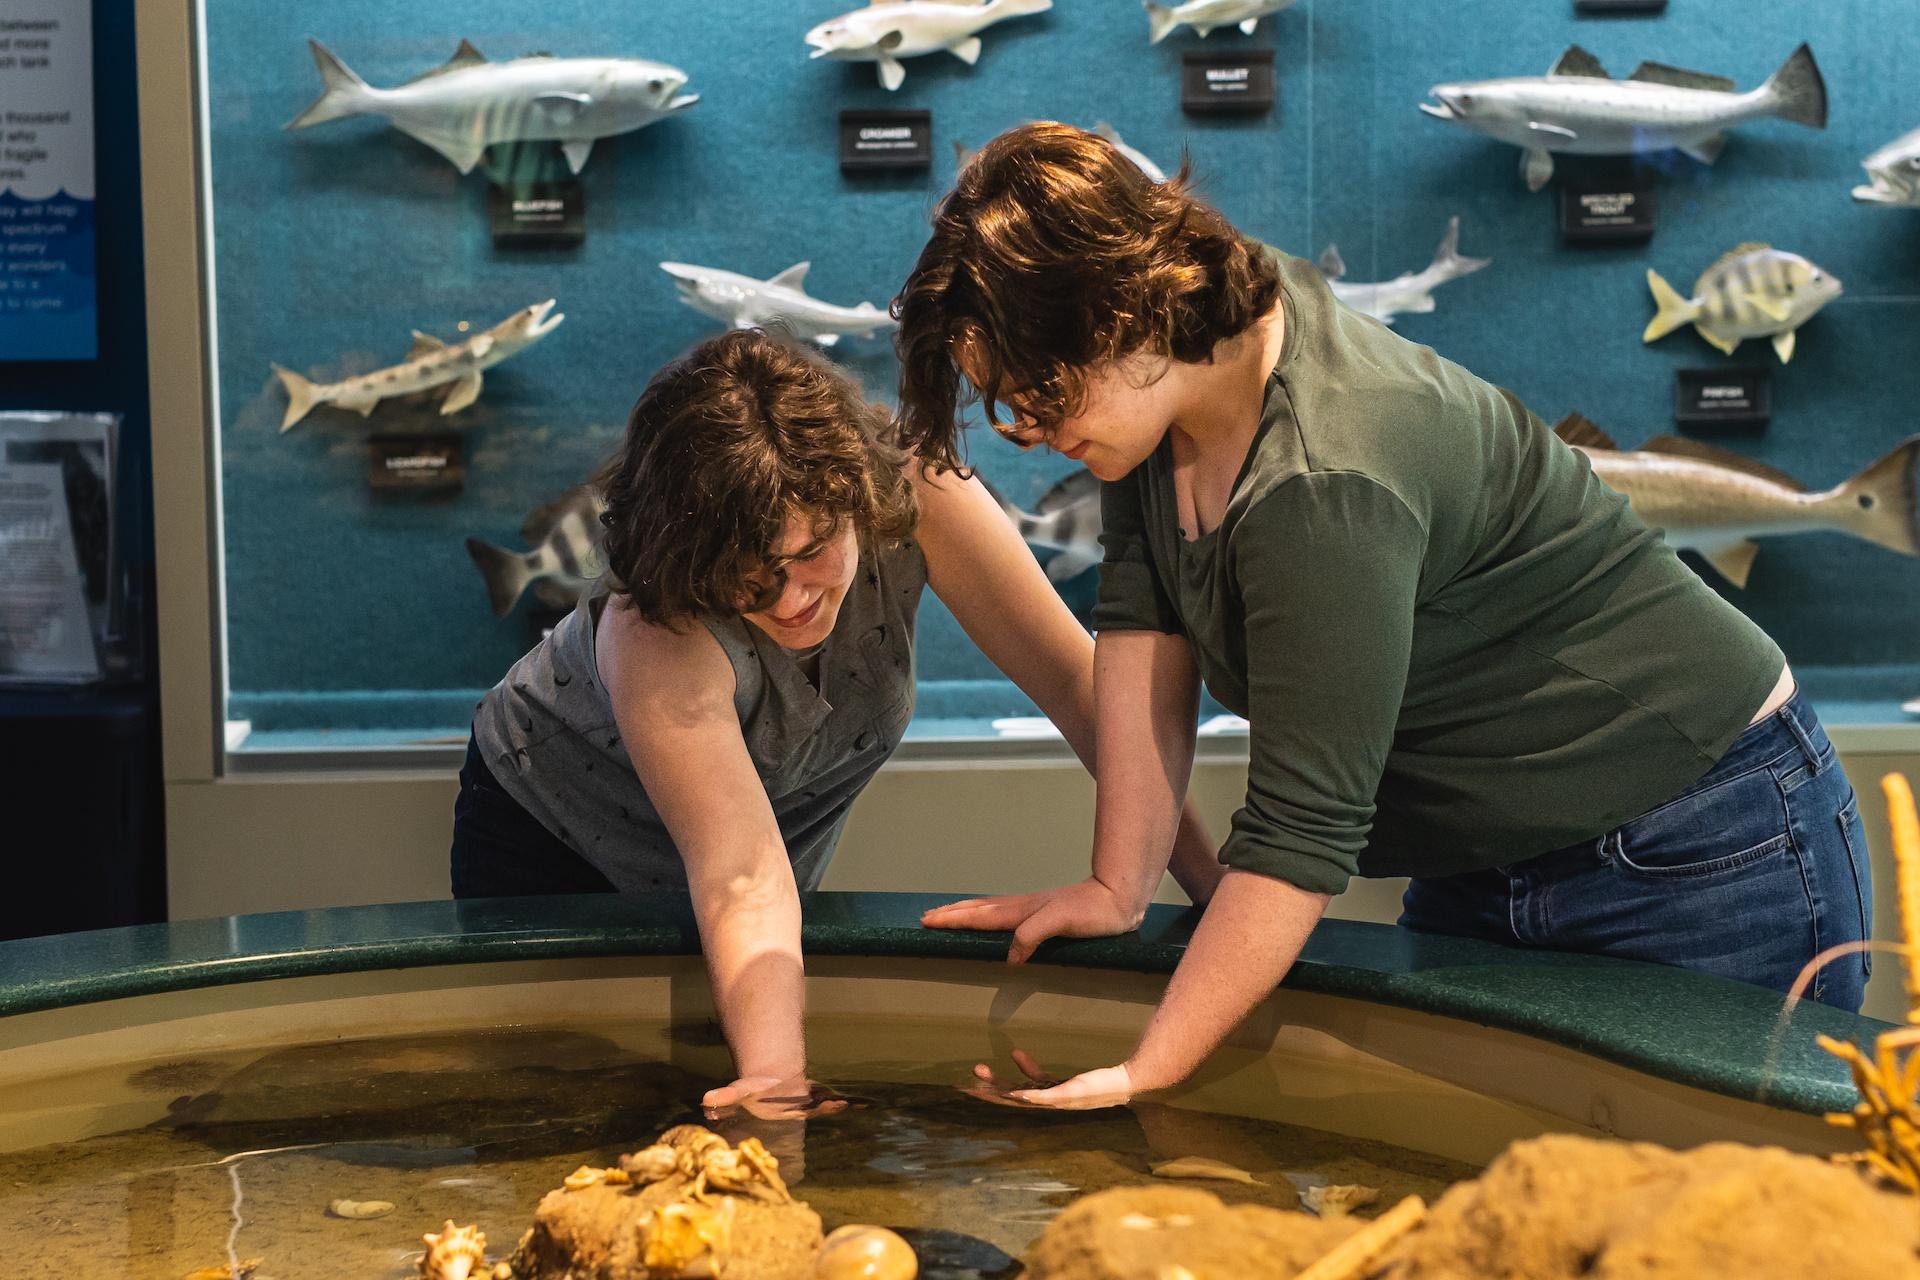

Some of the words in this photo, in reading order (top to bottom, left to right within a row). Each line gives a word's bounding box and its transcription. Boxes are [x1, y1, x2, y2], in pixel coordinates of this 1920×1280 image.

[14, 40, 50, 51] more
[20, 56, 50, 69] tank
[6, 111, 70, 125] thousand
[7, 131, 36, 142] who
[4, 149, 48, 165] fragile
[46, 205, 77, 219] help
[2, 223, 67, 236] spectrum
